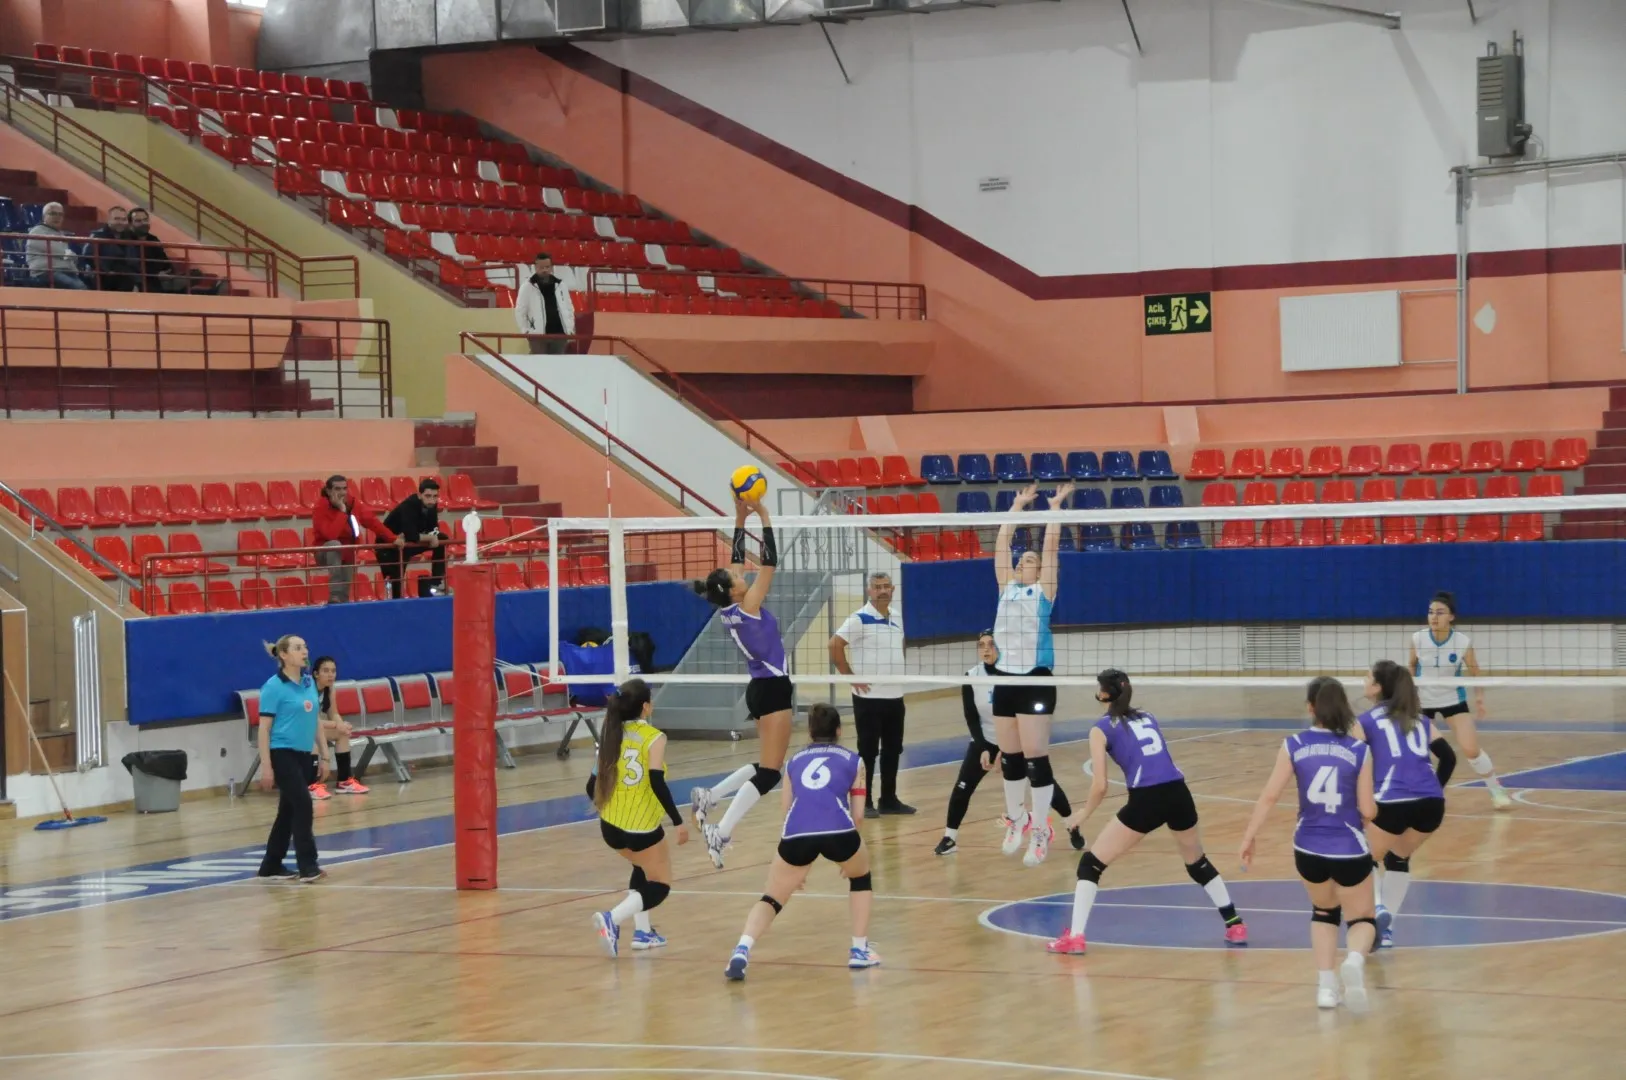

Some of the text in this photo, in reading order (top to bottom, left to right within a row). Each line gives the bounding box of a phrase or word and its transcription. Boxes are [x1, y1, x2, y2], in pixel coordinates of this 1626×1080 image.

[1146, 315, 1167, 327] ÇIKIŞ
[1148, 302, 1165, 313] ACİL
[1127, 717, 1163, 756] 5
[1375, 718, 1428, 758] 10
[622, 747, 644, 786] 3
[800, 756, 831, 790] 6
[1306, 765, 1342, 814] 4
